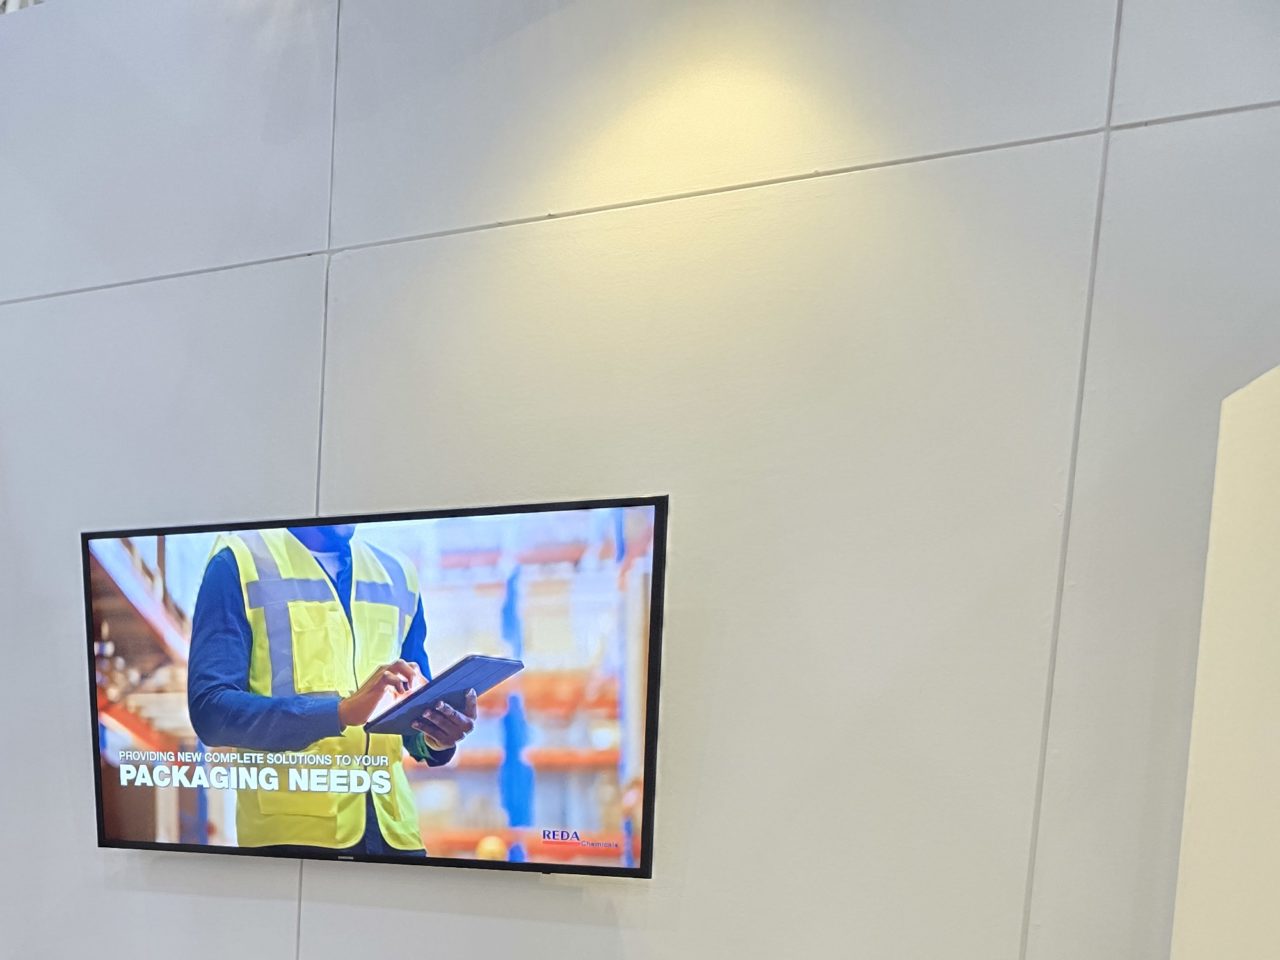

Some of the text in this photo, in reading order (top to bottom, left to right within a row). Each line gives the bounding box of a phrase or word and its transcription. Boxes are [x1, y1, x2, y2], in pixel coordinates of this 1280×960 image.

[119, 750, 389, 767] PROVIDING NEW COMPLETE SOLUTIONS TO YOUR
[119, 763, 392, 794] PACKAGING NEEDS
[542, 829, 580, 842] REDA
